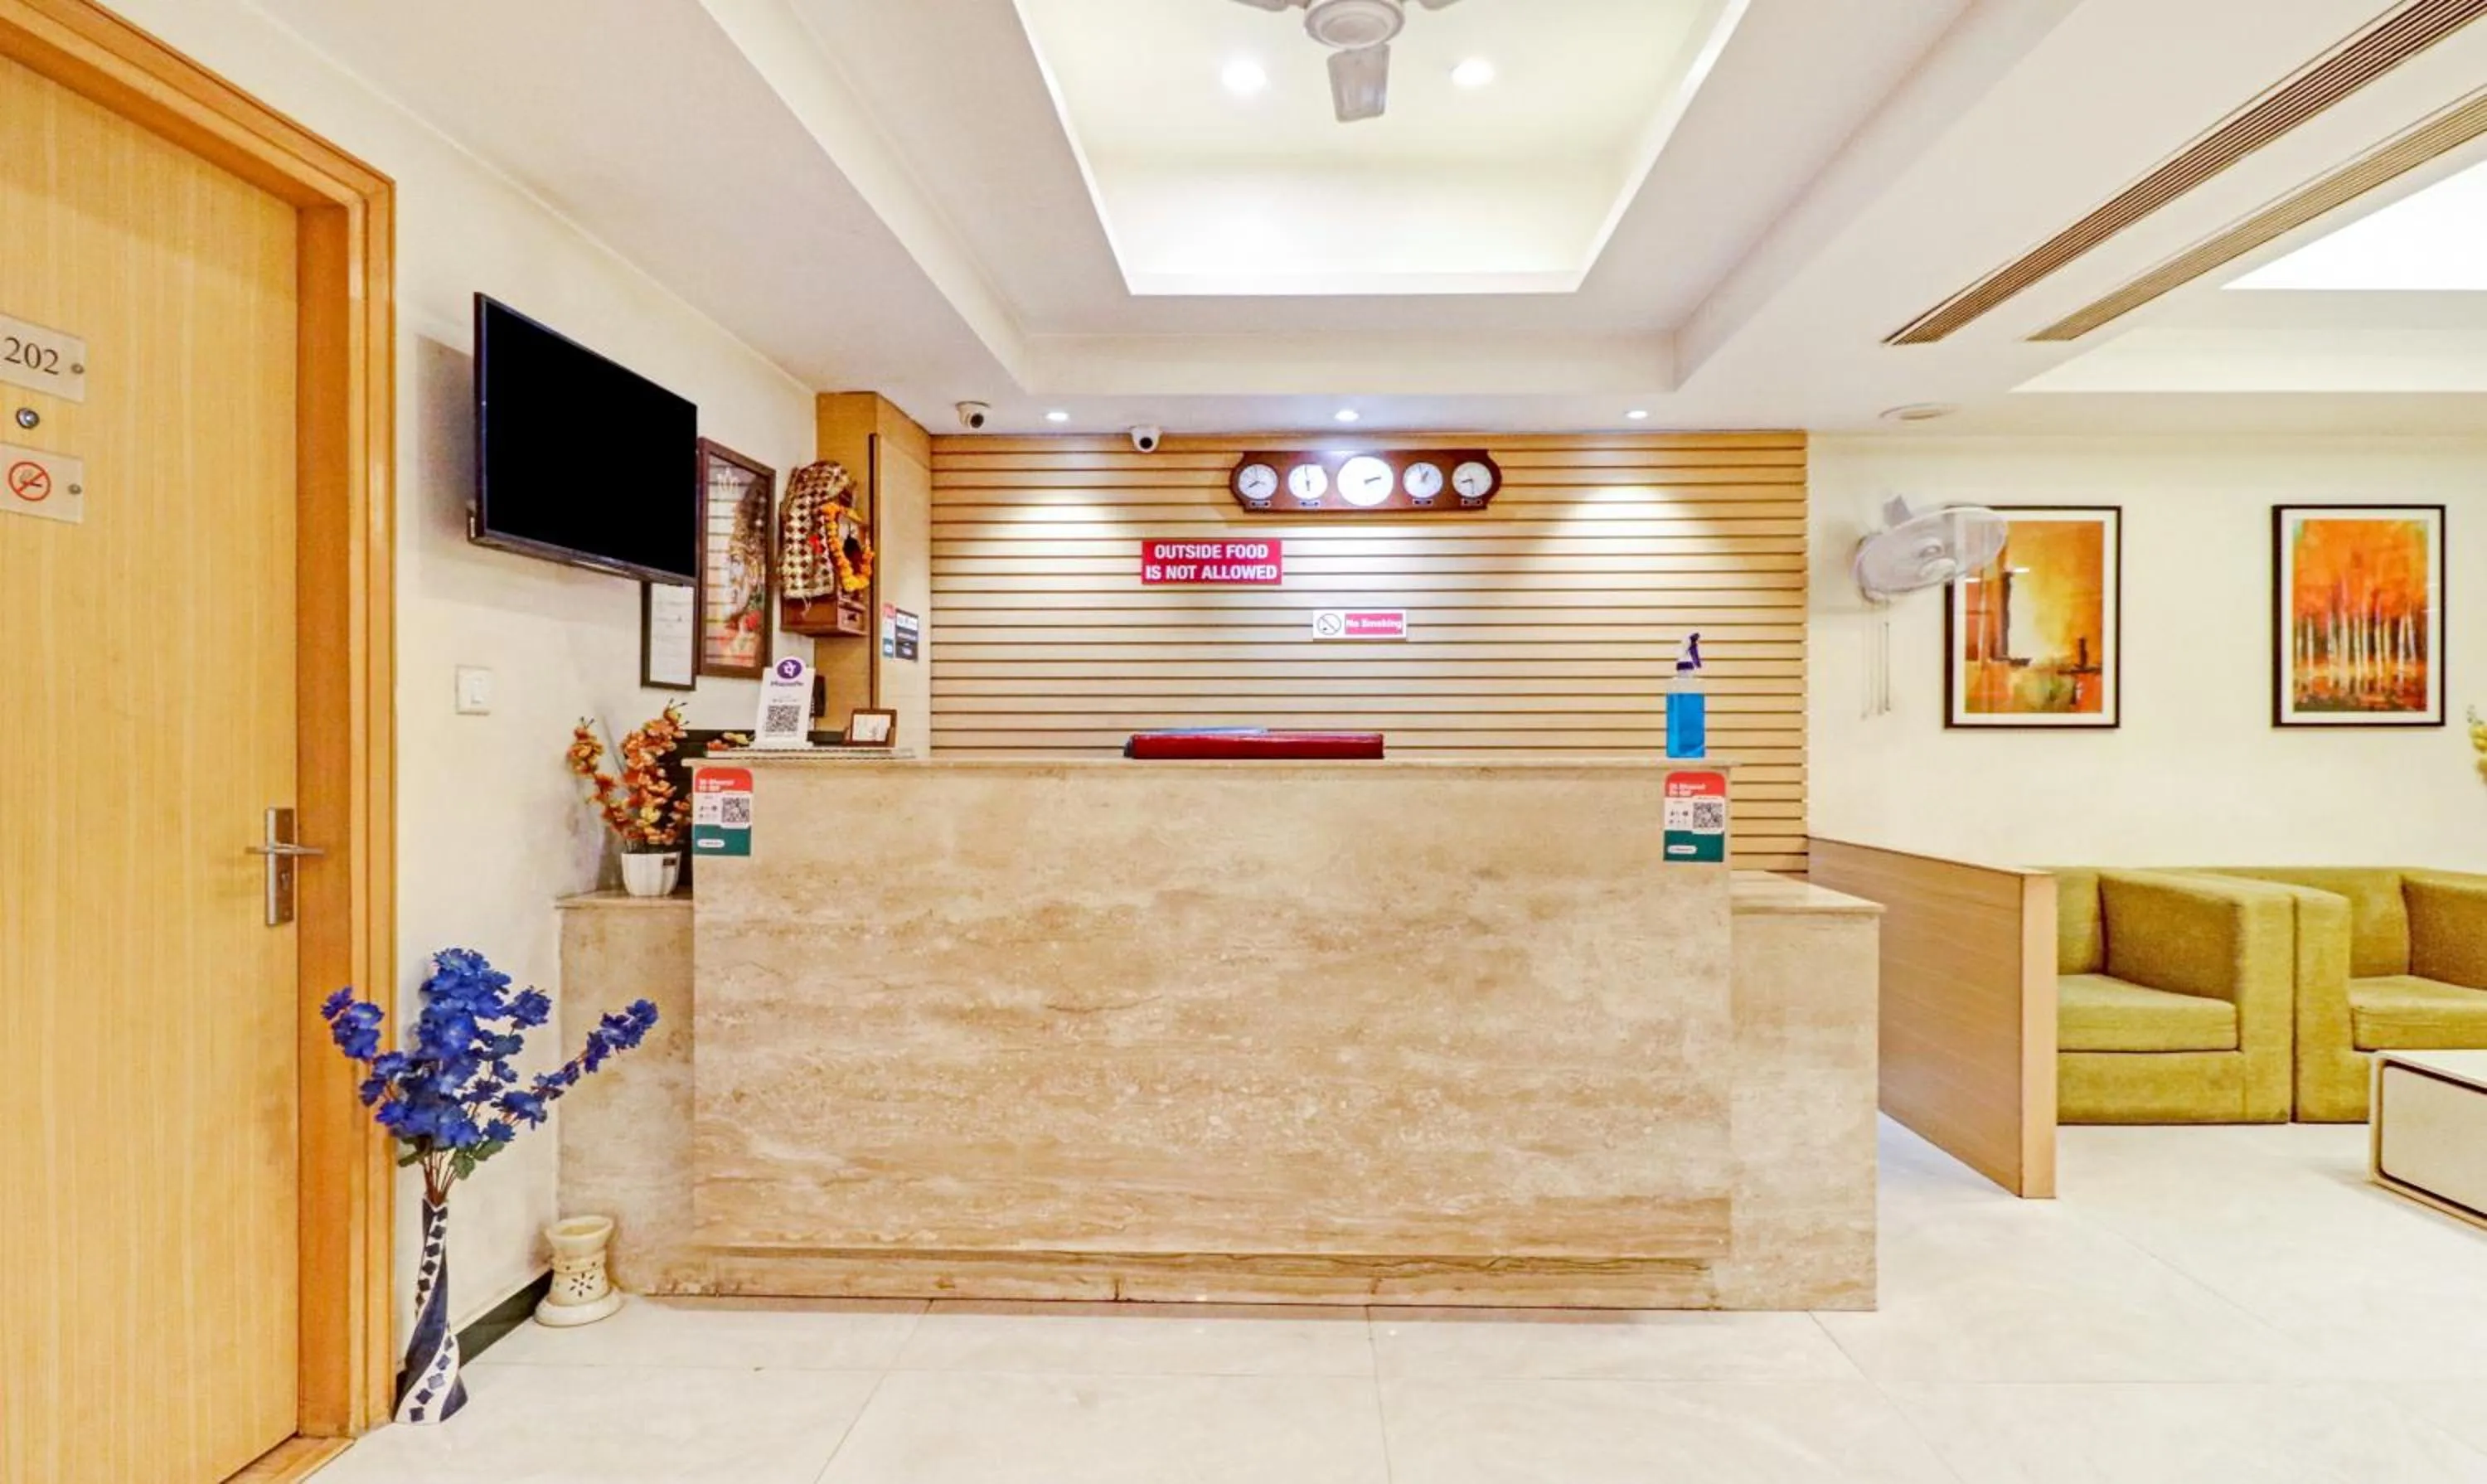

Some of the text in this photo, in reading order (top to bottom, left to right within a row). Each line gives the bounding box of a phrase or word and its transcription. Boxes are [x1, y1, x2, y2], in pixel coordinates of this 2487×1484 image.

[3, 336, 60, 376] 202
[1154, 544, 1268, 560] OUTSIDE FOOD
[1146, 565, 1277, 580] IS NOT ALLOWED
[1345, 619, 1402, 630] No Smoking
